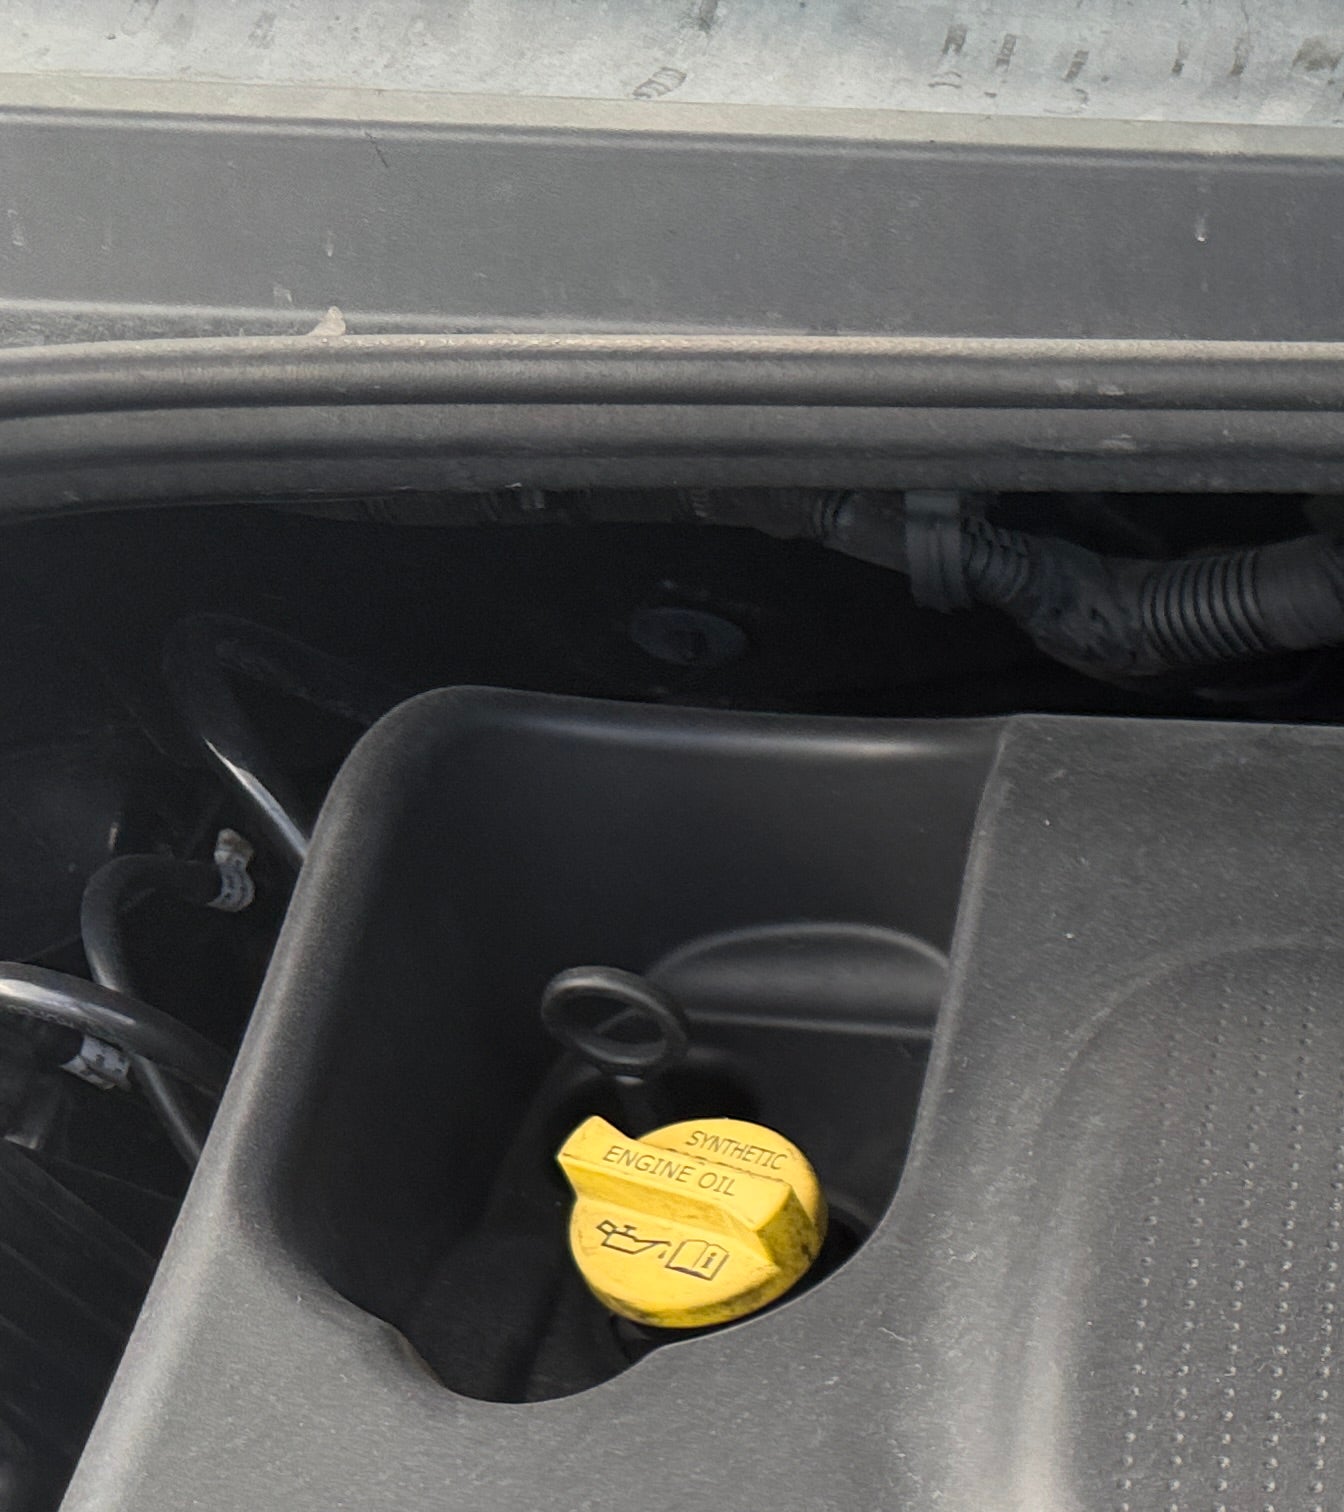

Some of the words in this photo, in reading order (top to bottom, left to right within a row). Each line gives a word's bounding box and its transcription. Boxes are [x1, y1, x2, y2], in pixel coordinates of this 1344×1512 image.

[602, 1145, 693, 1183] ENGINE
[698, 1170, 736, 1197] OIL
[685, 1129, 788, 1170] SYNTHETIC
